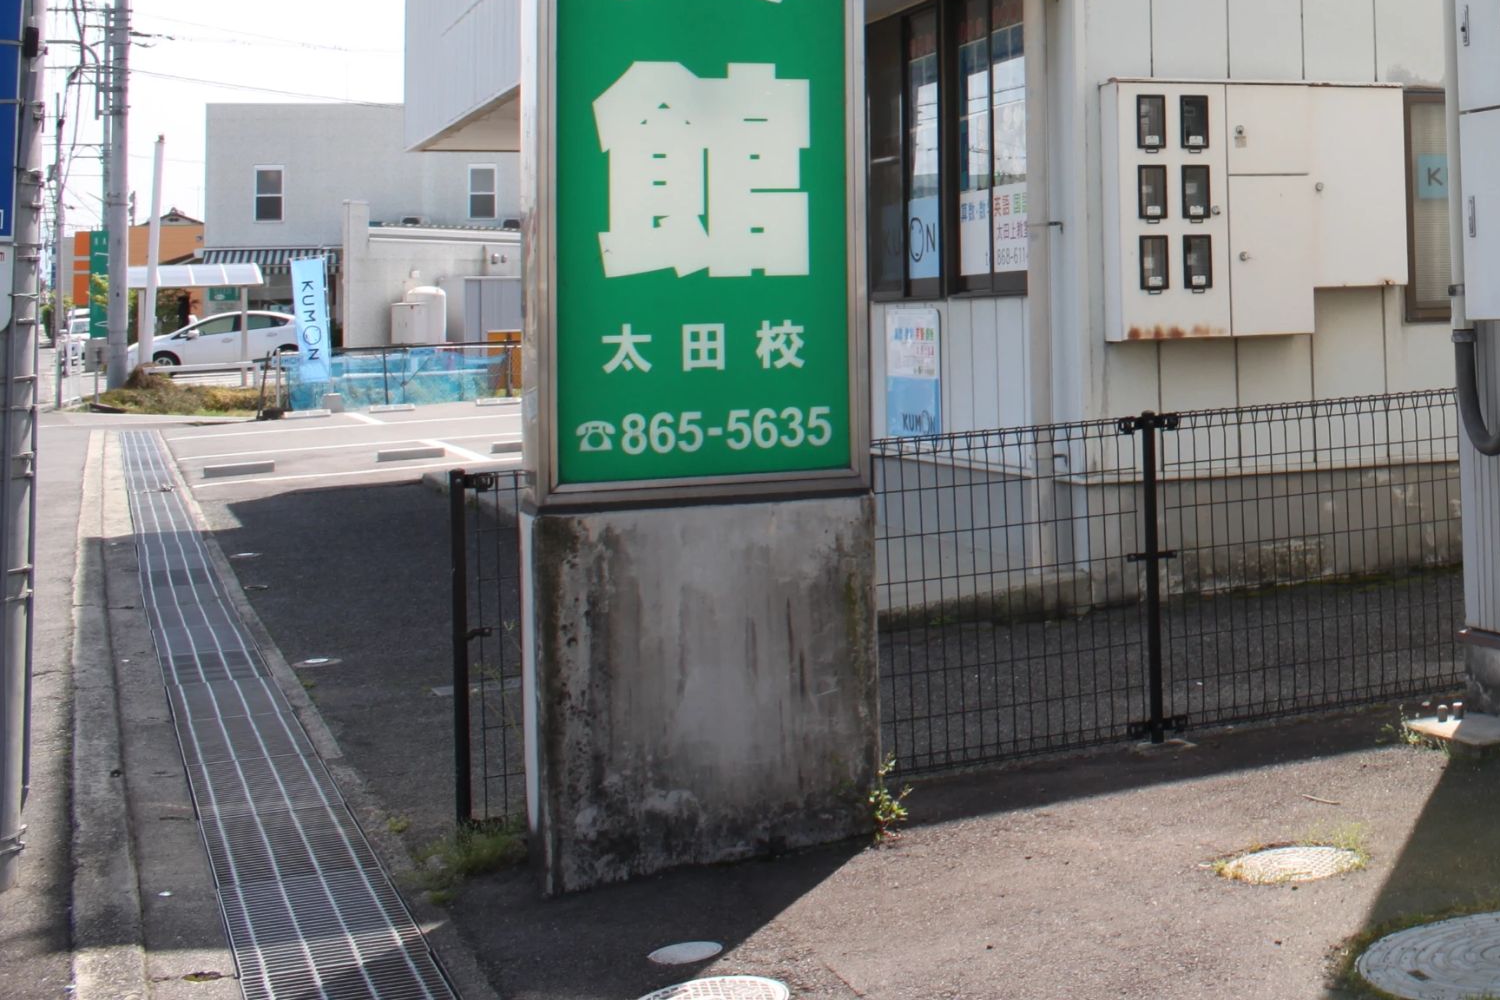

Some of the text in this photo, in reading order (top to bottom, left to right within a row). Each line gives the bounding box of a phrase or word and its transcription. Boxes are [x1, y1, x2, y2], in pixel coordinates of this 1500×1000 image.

[997, 247, 1029, 266] 868-611
[301, 279, 322, 361] KUMON
[601, 319, 806, 374] 太田校
[620, 406, 833, 455] 865-5635
